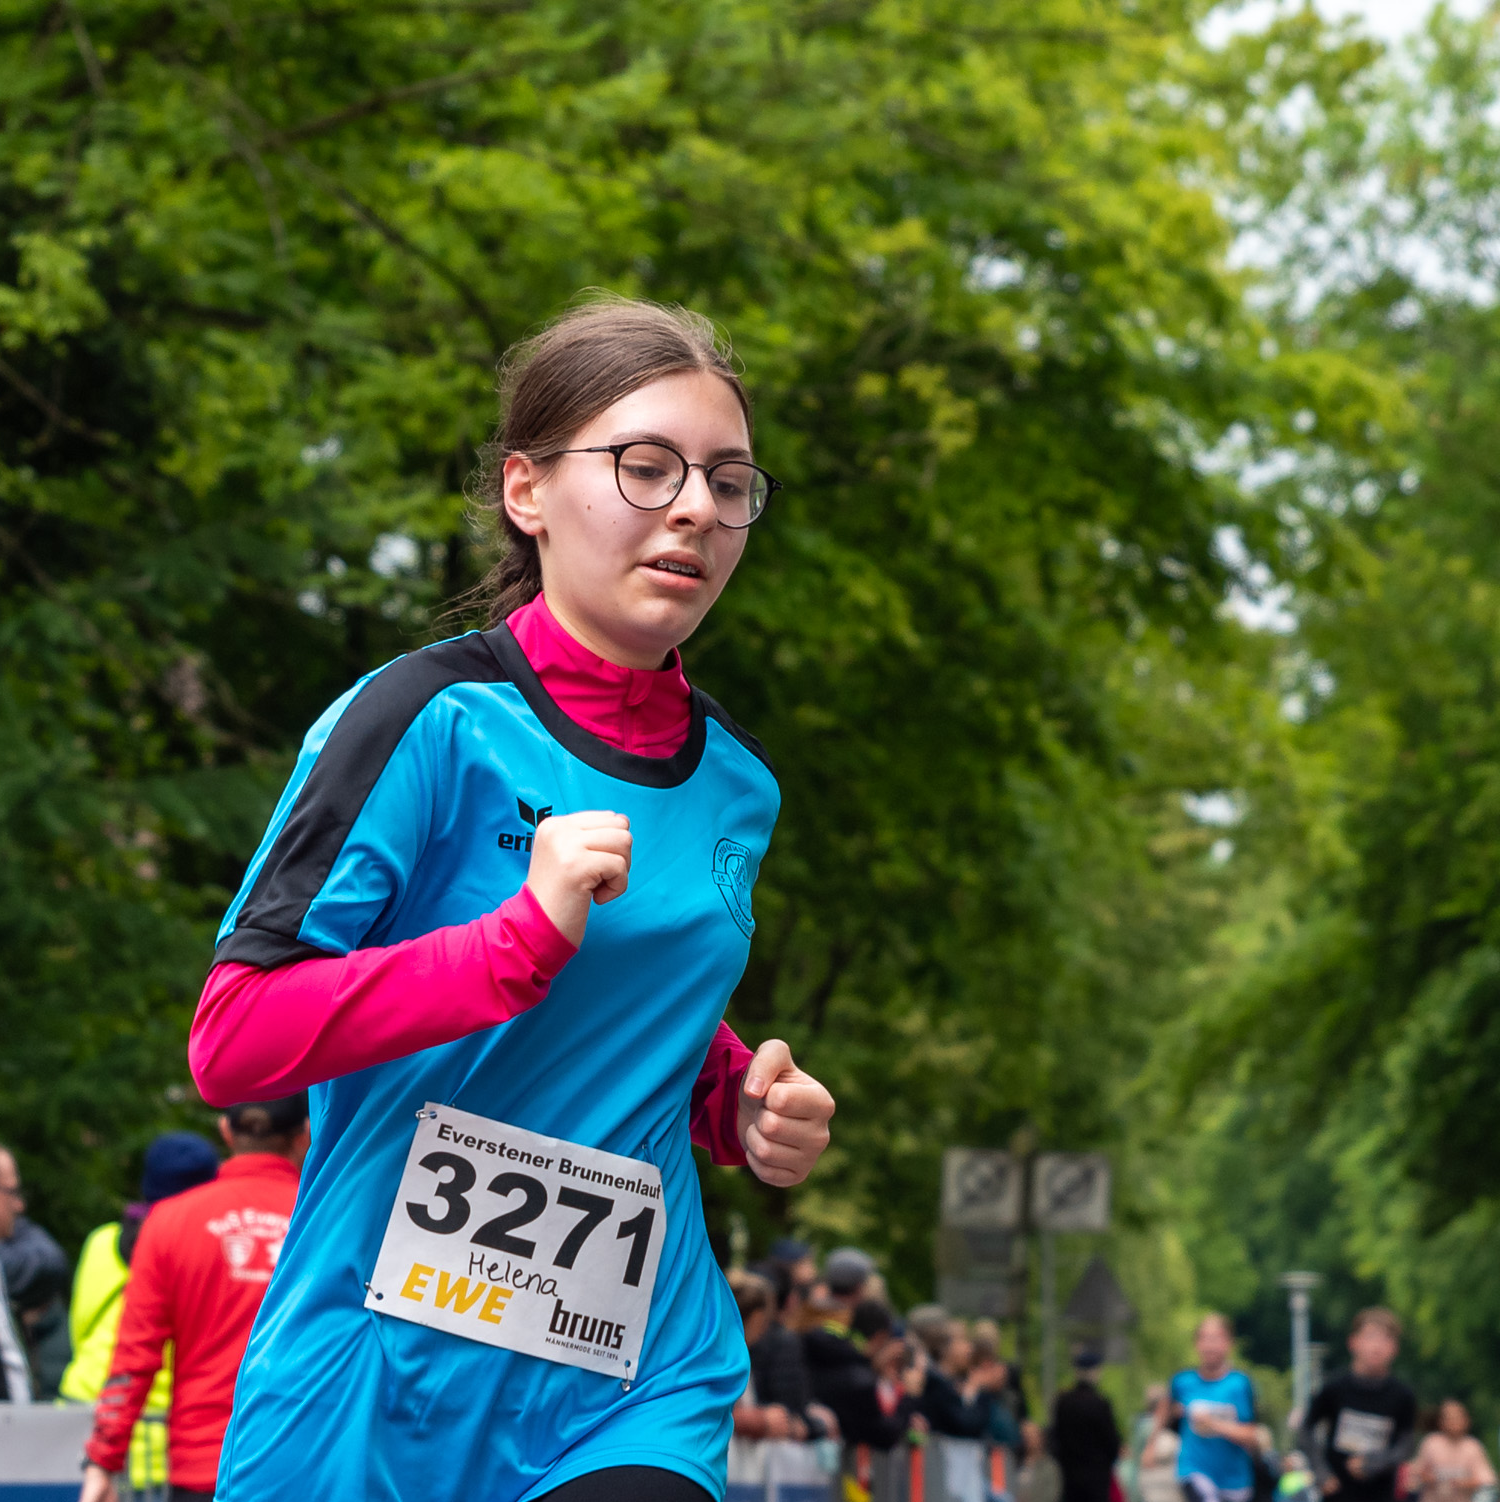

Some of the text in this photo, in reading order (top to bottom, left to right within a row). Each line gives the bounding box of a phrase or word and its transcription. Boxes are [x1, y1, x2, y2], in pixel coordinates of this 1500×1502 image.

[437, 1123, 661, 1200] Everstener Brunnenlauf
[405, 1151, 656, 1288] 3271
[400, 1262, 514, 1325] EWE
[469, 1252, 558, 1298] Helena
[549, 1299, 626, 1350] bruns
